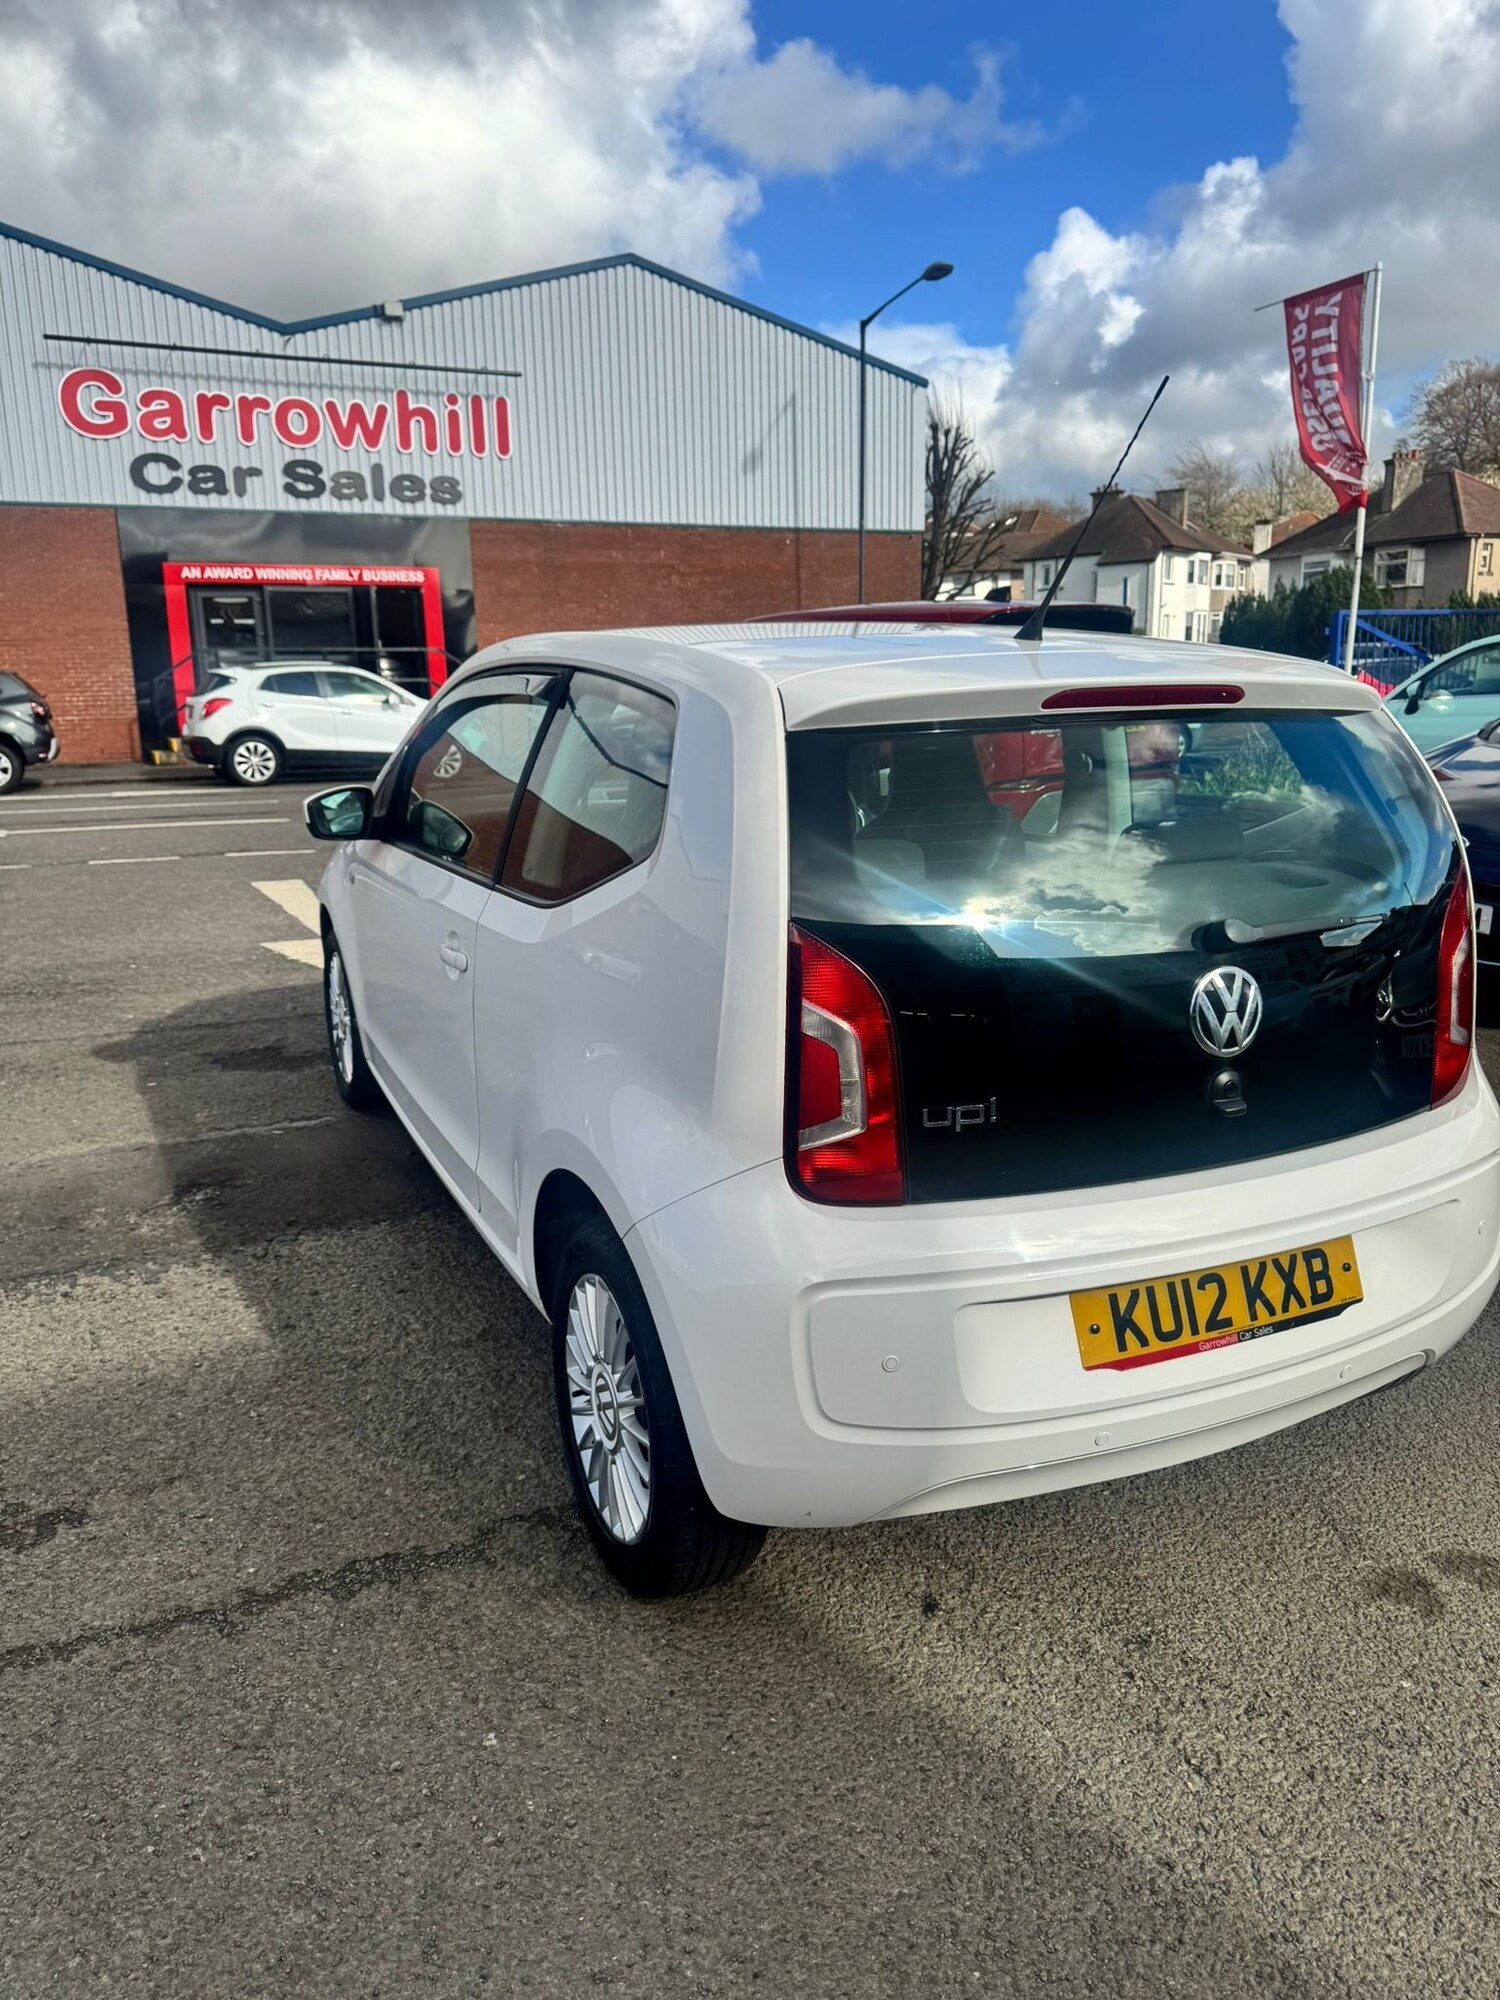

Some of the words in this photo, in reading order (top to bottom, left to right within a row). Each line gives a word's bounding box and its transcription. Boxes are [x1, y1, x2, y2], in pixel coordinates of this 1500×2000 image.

[58, 366, 514, 460] Garrowhill
[129, 452, 263, 497] Car
[282, 459, 464, 506] Sales
[181, 566, 202, 579] AN
[203, 567, 254, 580] AWARD
[256, 568, 313, 582] WINNING
[314, 569, 361, 582] FAMILY
[362, 570, 425, 583] BUSINESS
[922, 1096, 997, 1133] up!
[1108, 1272, 1233, 1353] KU12
[1240, 1248, 1334, 1323] KXB
[1198, 1333, 1239, 1352] Garrowhill
[1239, 1330, 1253, 1341] Car
[1254, 1325, 1274, 1338] Sales
